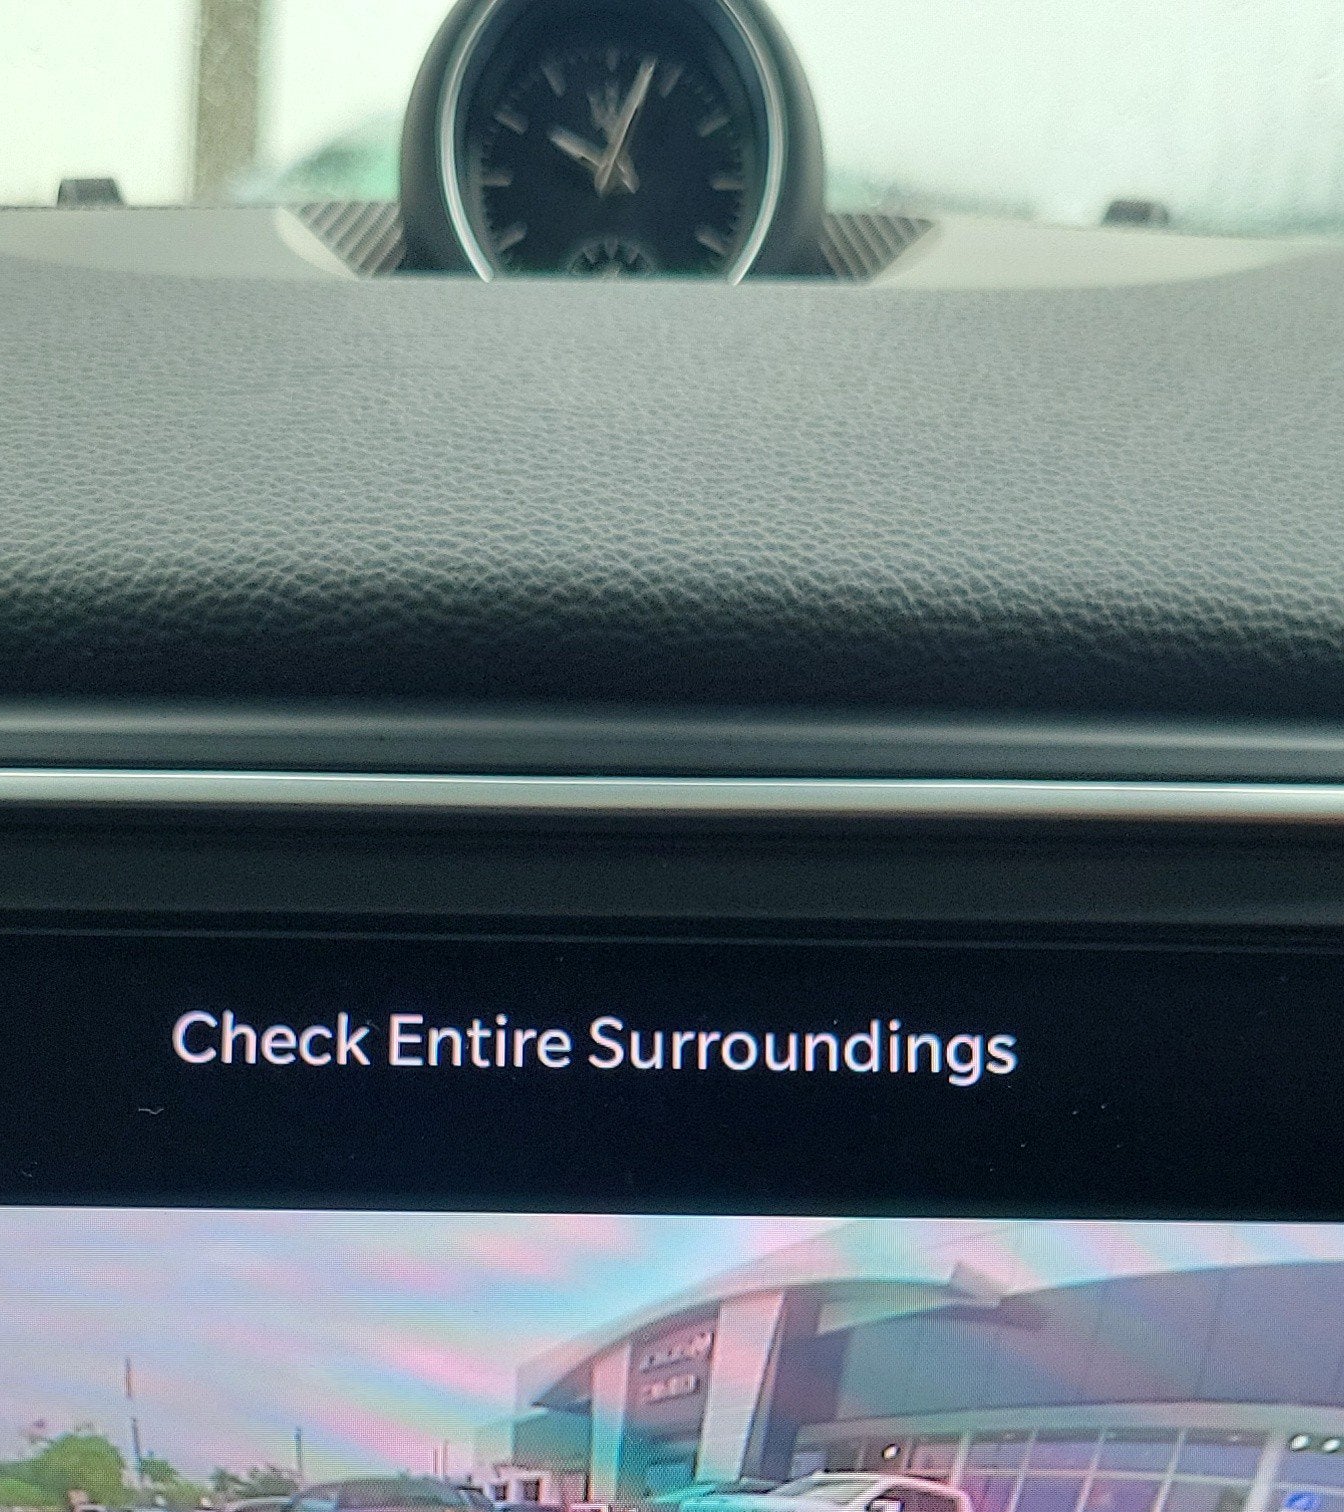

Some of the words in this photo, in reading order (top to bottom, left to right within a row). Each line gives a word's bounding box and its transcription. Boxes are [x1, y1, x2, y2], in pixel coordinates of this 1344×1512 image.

[172, 1010, 371, 1066] Check
[389, 1014, 572, 1068] Entire
[588, 1016, 1017, 1087] Surroundings
